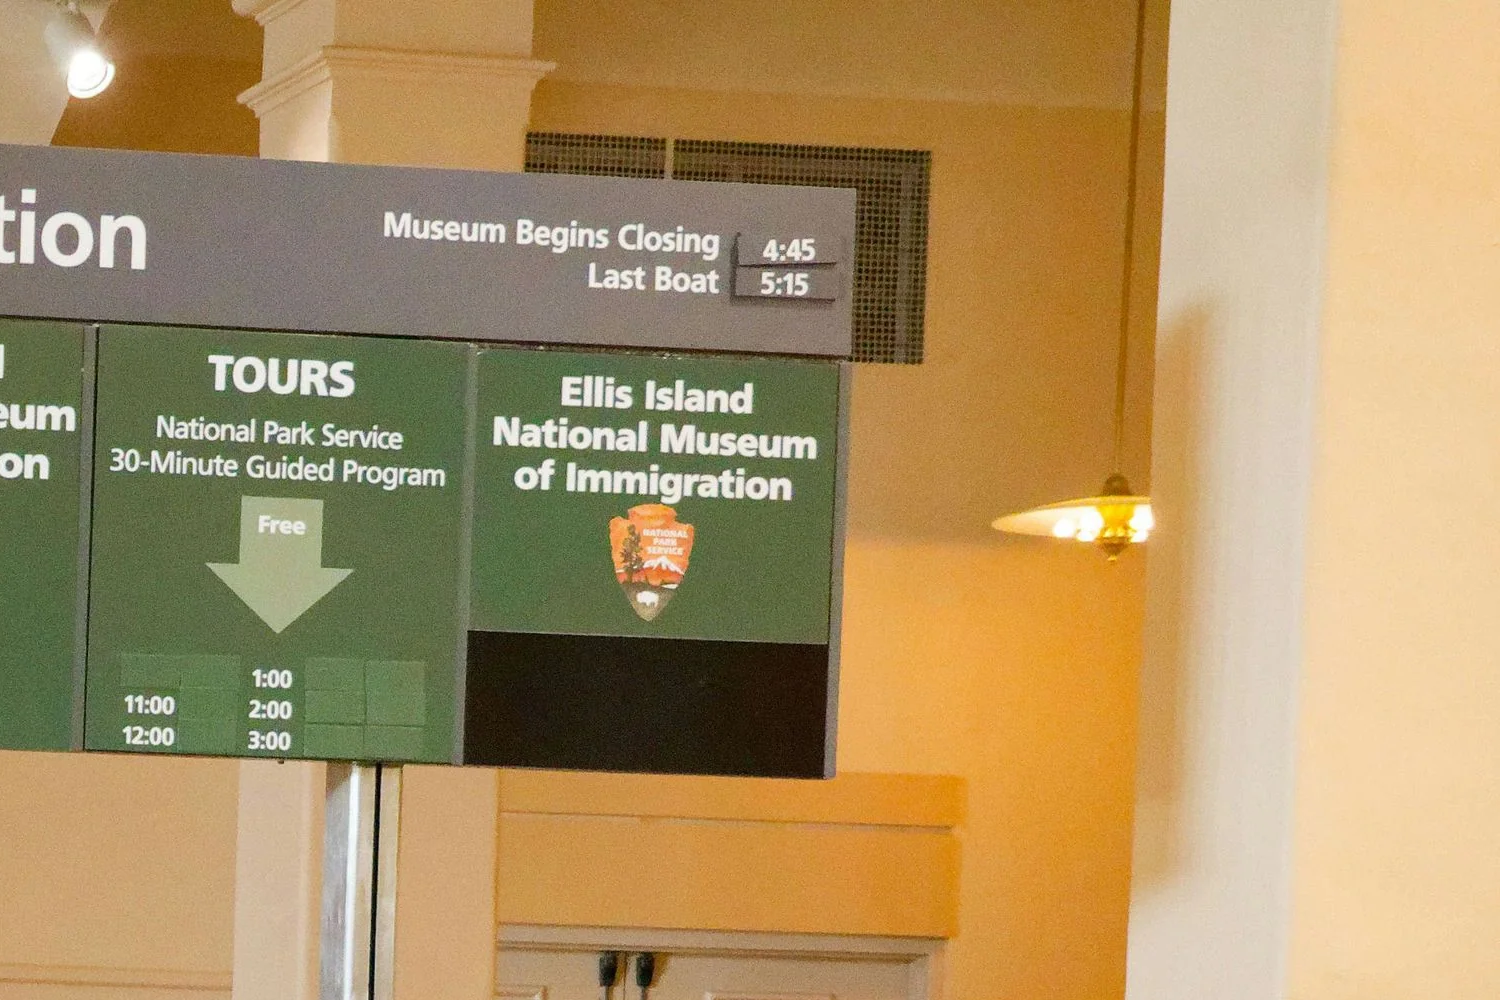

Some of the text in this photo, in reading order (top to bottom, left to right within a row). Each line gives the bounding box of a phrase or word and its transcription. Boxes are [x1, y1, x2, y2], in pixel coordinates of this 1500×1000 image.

[383, 211, 816, 262] Museum Begins Closing 4:45
[588, 262, 810, 297] Last Boat 5:15
[207, 354, 356, 398] TOURS
[561, 375, 754, 414] Ellis Island
[156, 415, 404, 451] National Park Service
[492, 415, 818, 460] National Museum
[109, 447, 446, 491] 30-Minute Guided Program
[513, 458, 793, 505] of Immigration
[258, 514, 307, 535] Free
[643, 528, 688, 538] NATIONAL
[646, 547, 684, 556] SERVICE
[653, 538, 677, 546] PARK
[252, 668, 293, 689] 1:00
[124, 694, 176, 716] 11:00
[248, 699, 293, 720] 2:00
[122, 725, 175, 747] 12:00
[247, 730, 292, 751] 3:00
